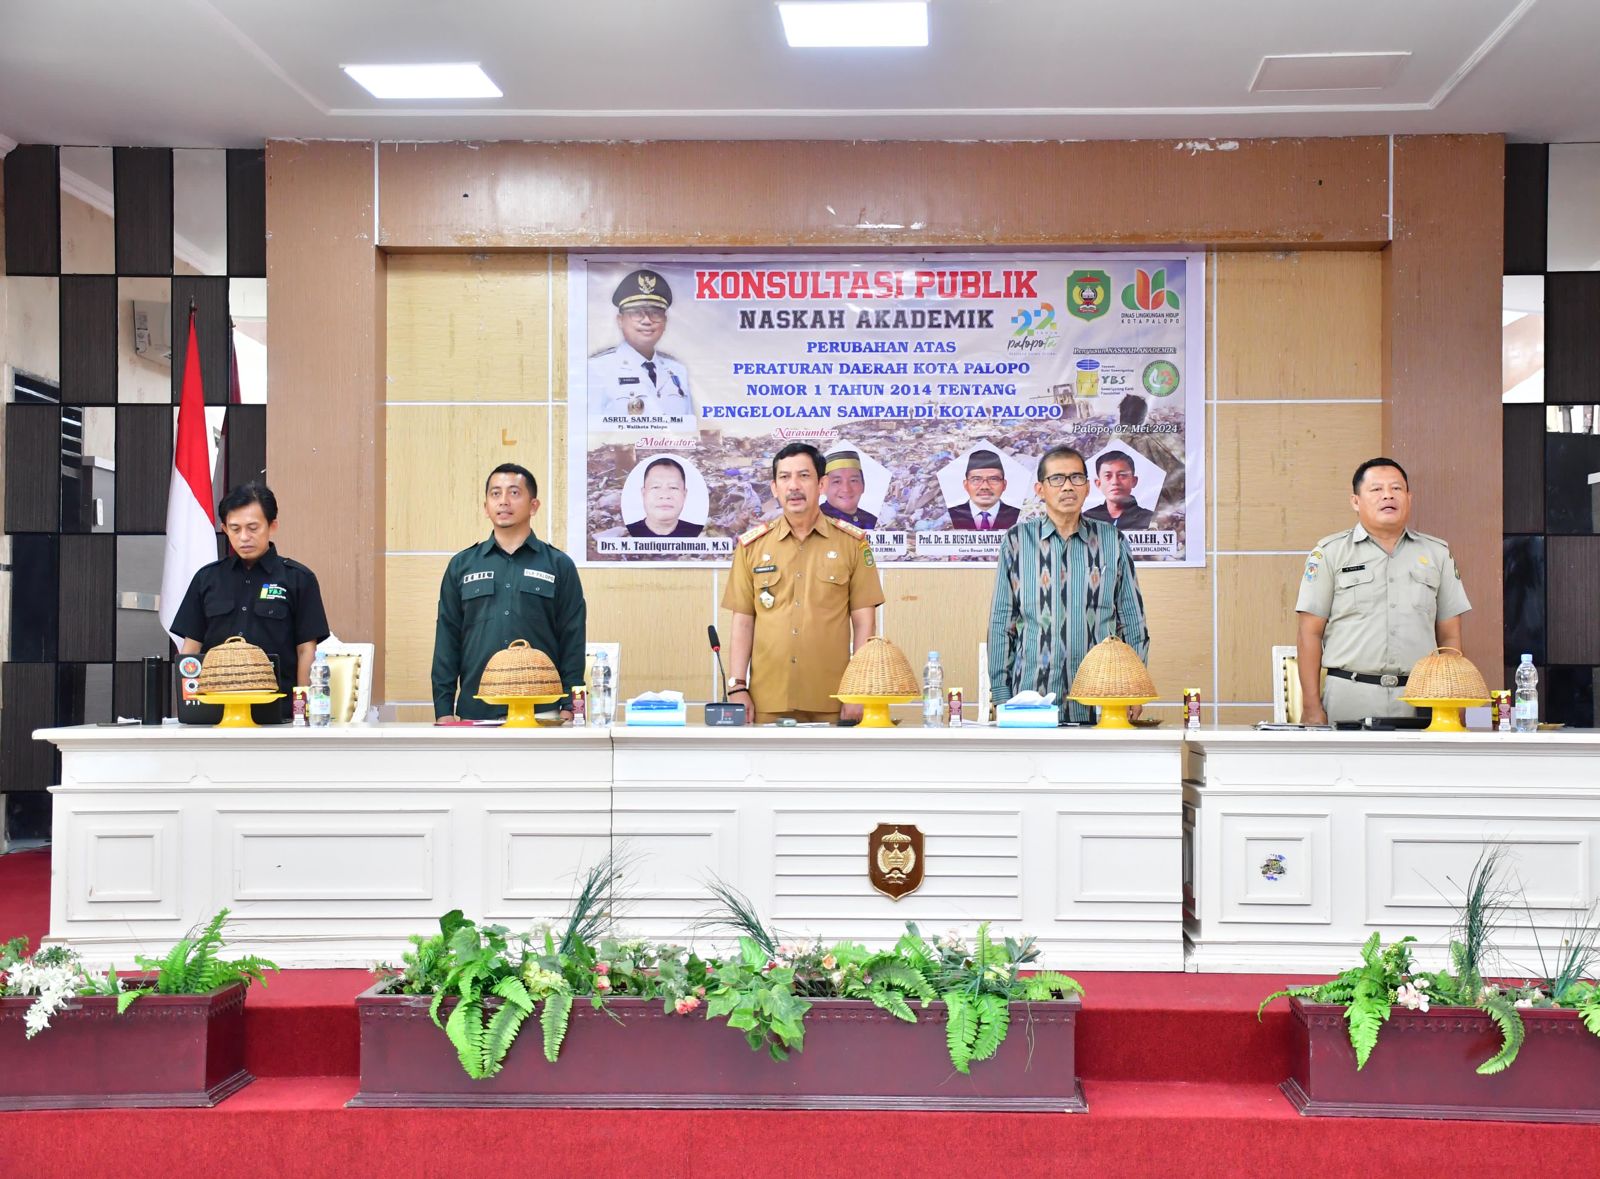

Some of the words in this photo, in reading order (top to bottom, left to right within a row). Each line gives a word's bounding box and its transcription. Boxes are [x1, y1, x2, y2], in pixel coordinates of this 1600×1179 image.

[696, 271, 904, 299] KONSULTASI
[914, 270, 1037, 299] PUBLIK
[740, 310, 845, 329] NASKAH
[856, 310, 994, 328] AKADEMIK
[807, 341, 908, 353] PERUBAHAN
[914, 341, 957, 353] ATAS
[733, 363, 833, 375] PERATURAN
[839, 363, 908, 374] DAERAH
[913, 363, 959, 374] KOTA
[964, 362, 1030, 374] PALOPO
[1102, 376, 1125, 384] YBS
[747, 384, 808, 396] NOMOR
[814, 384, 822, 395] 1
[828, 384, 884, 395] TAHUN
[890, 384, 931, 395] 2014
[937, 384, 1016, 395] TENTANG
[702, 406, 831, 418] PENGELOLAAN
[837, 406, 908, 418] SAMPAH
[915, 405, 934, 417] DI
[939, 405, 987, 417] KOTA
[992, 405, 1061, 417] PALOPO
[1073, 424, 1112, 435] Palopo,
[1115, 424, 1128, 433] 07
[1131, 424, 1149, 433] Mei
[1152, 424, 1177, 433] 2024
[636, 437, 695, 448] Moderator:
[876, 534, 891, 545] SH.,
[892, 534, 904, 544] MH
[919, 534, 932, 544] Prof.
[934, 534, 942, 544] Dr.
[944, 534, 951, 544] H.
[952, 534, 977, 544] RUSTAN
[977, 534, 1004, 544] SANTAR
[1128, 533, 1160, 545] SALEH,
[1163, 533, 1174, 544] ST
[601, 541, 618, 551] Drs.
[621, 541, 631, 550] M.
[712, 541, 729, 551] M.Si
